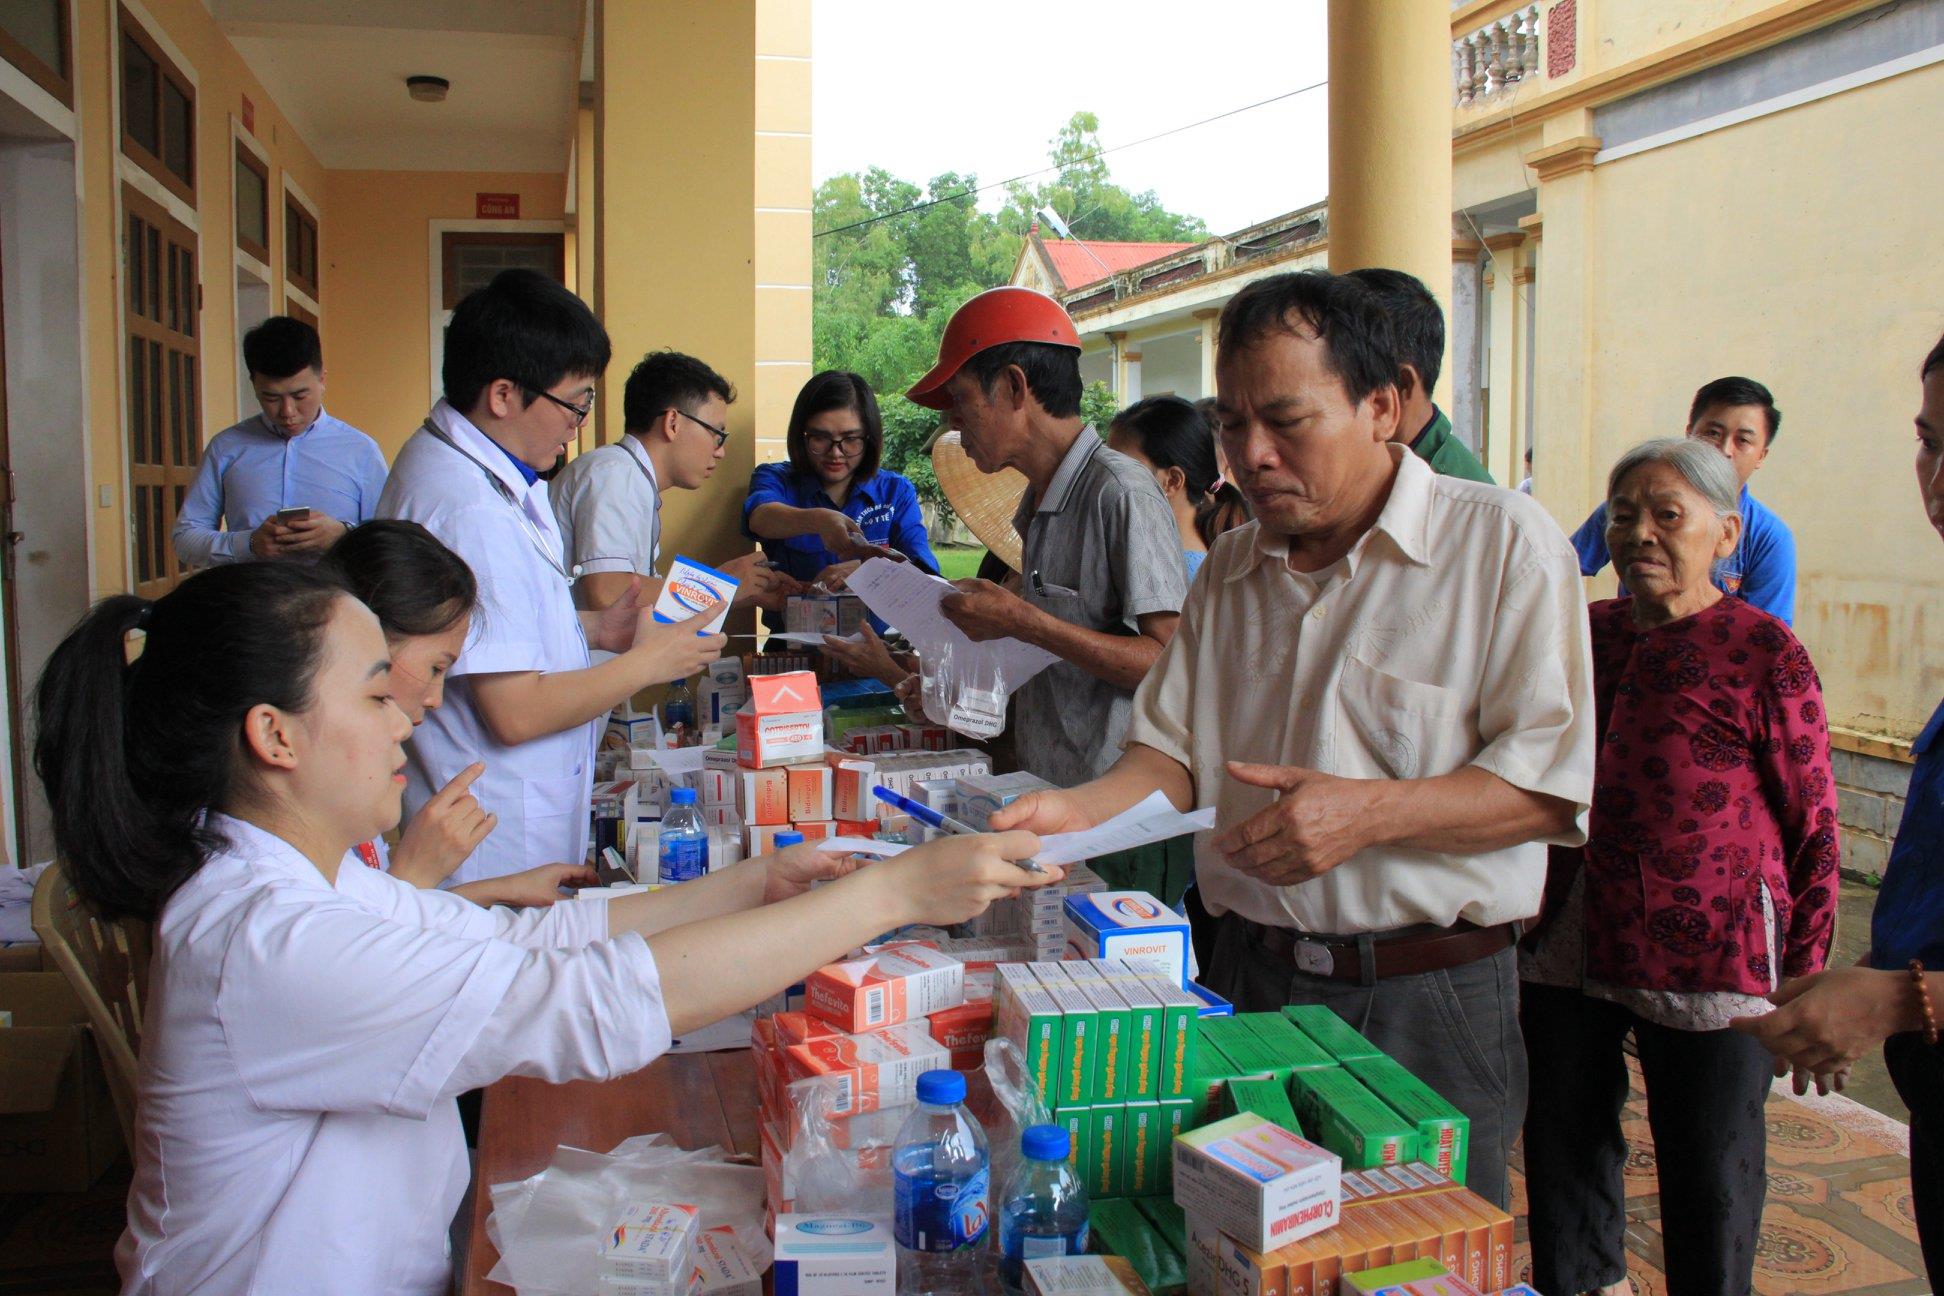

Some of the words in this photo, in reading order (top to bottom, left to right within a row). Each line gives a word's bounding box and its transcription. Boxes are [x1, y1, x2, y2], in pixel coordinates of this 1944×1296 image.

[1124, 945, 1168, 956] VINROVIT
[1270, 1199, 1333, 1238] CLORPHENIRAMIN
[1446, 1254, 1456, 1262] 5
[1471, 1250, 1481, 1258] 5
